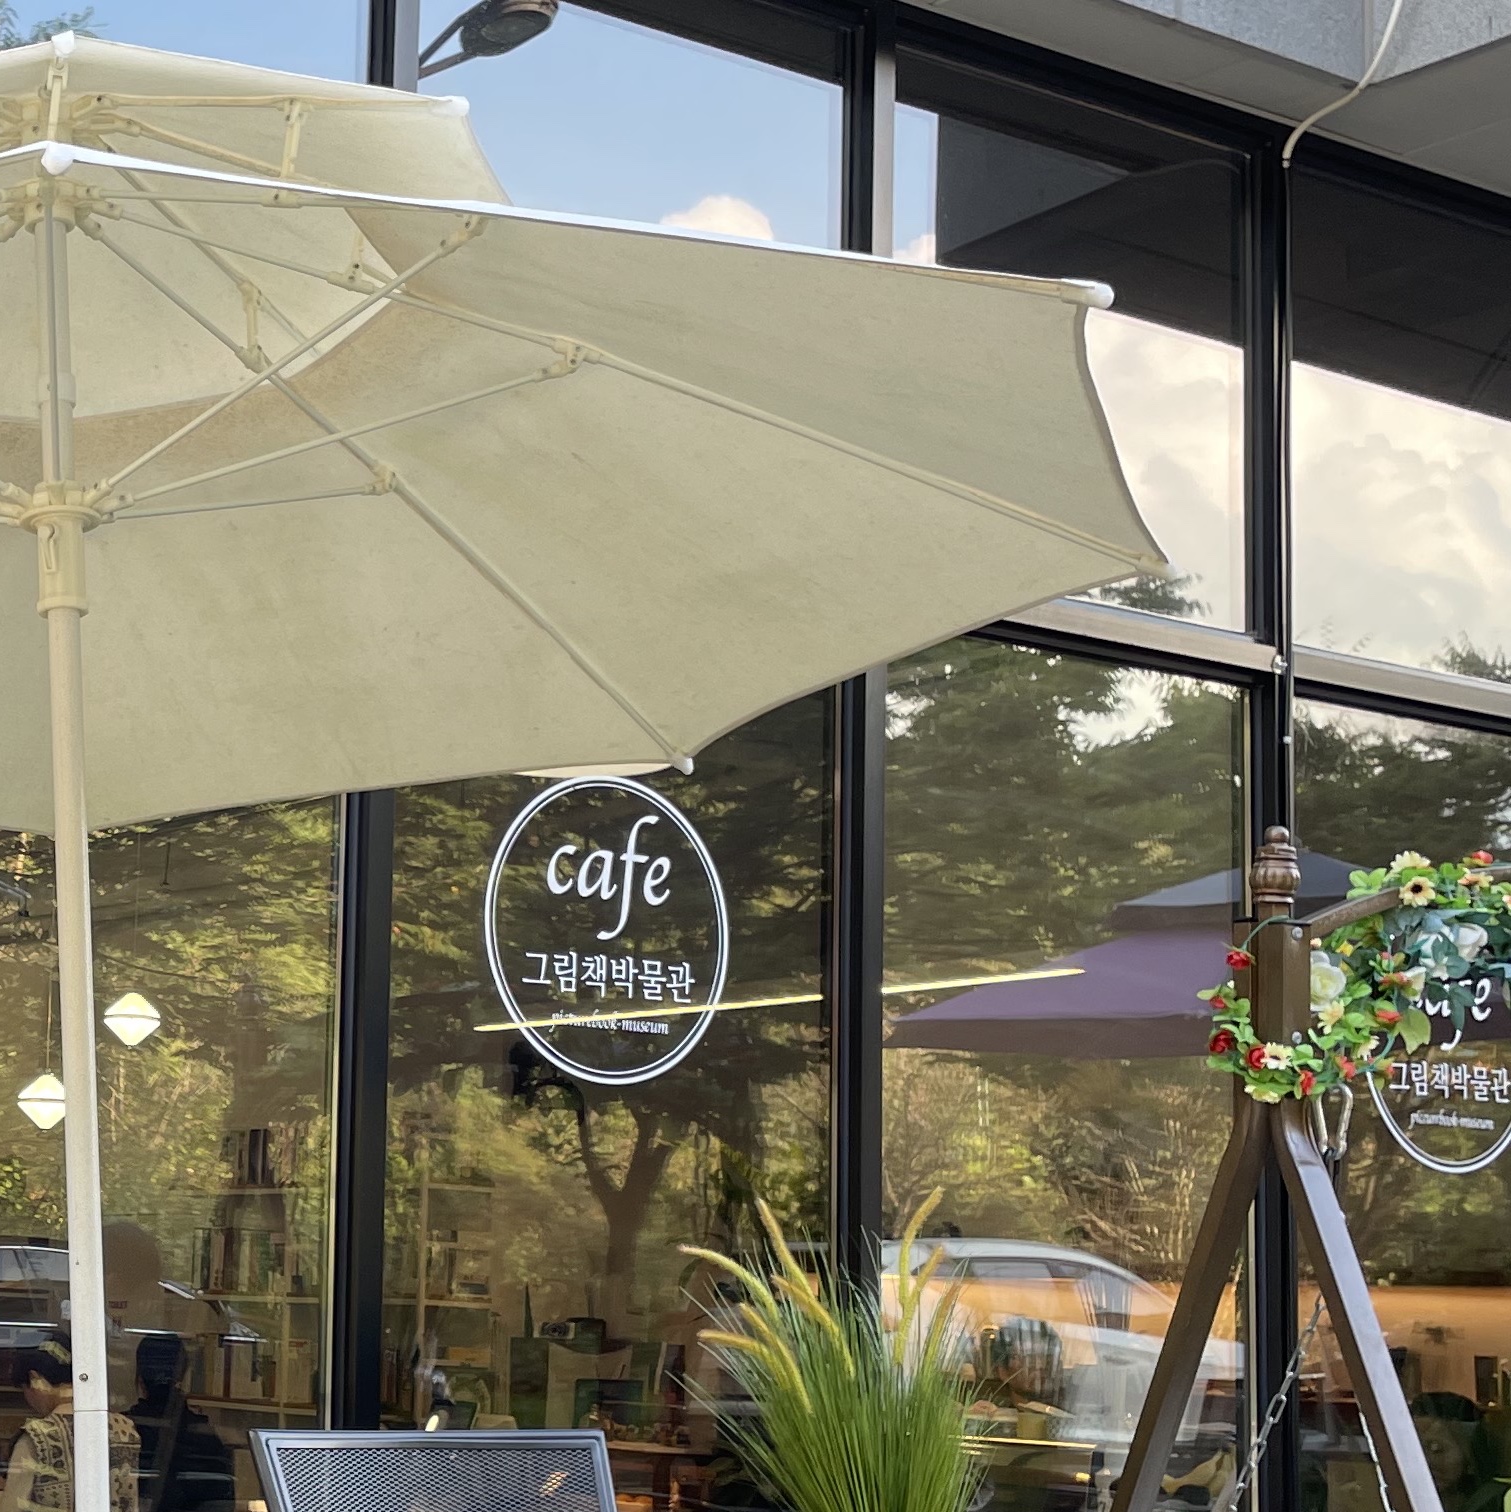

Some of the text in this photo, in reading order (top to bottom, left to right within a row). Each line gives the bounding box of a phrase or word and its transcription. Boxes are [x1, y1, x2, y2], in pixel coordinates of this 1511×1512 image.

[547, 815, 671, 940] cafe
[522, 952, 696, 1003] 그림책박물관
[1389, 1060, 1511, 1103] 그림책박물관
